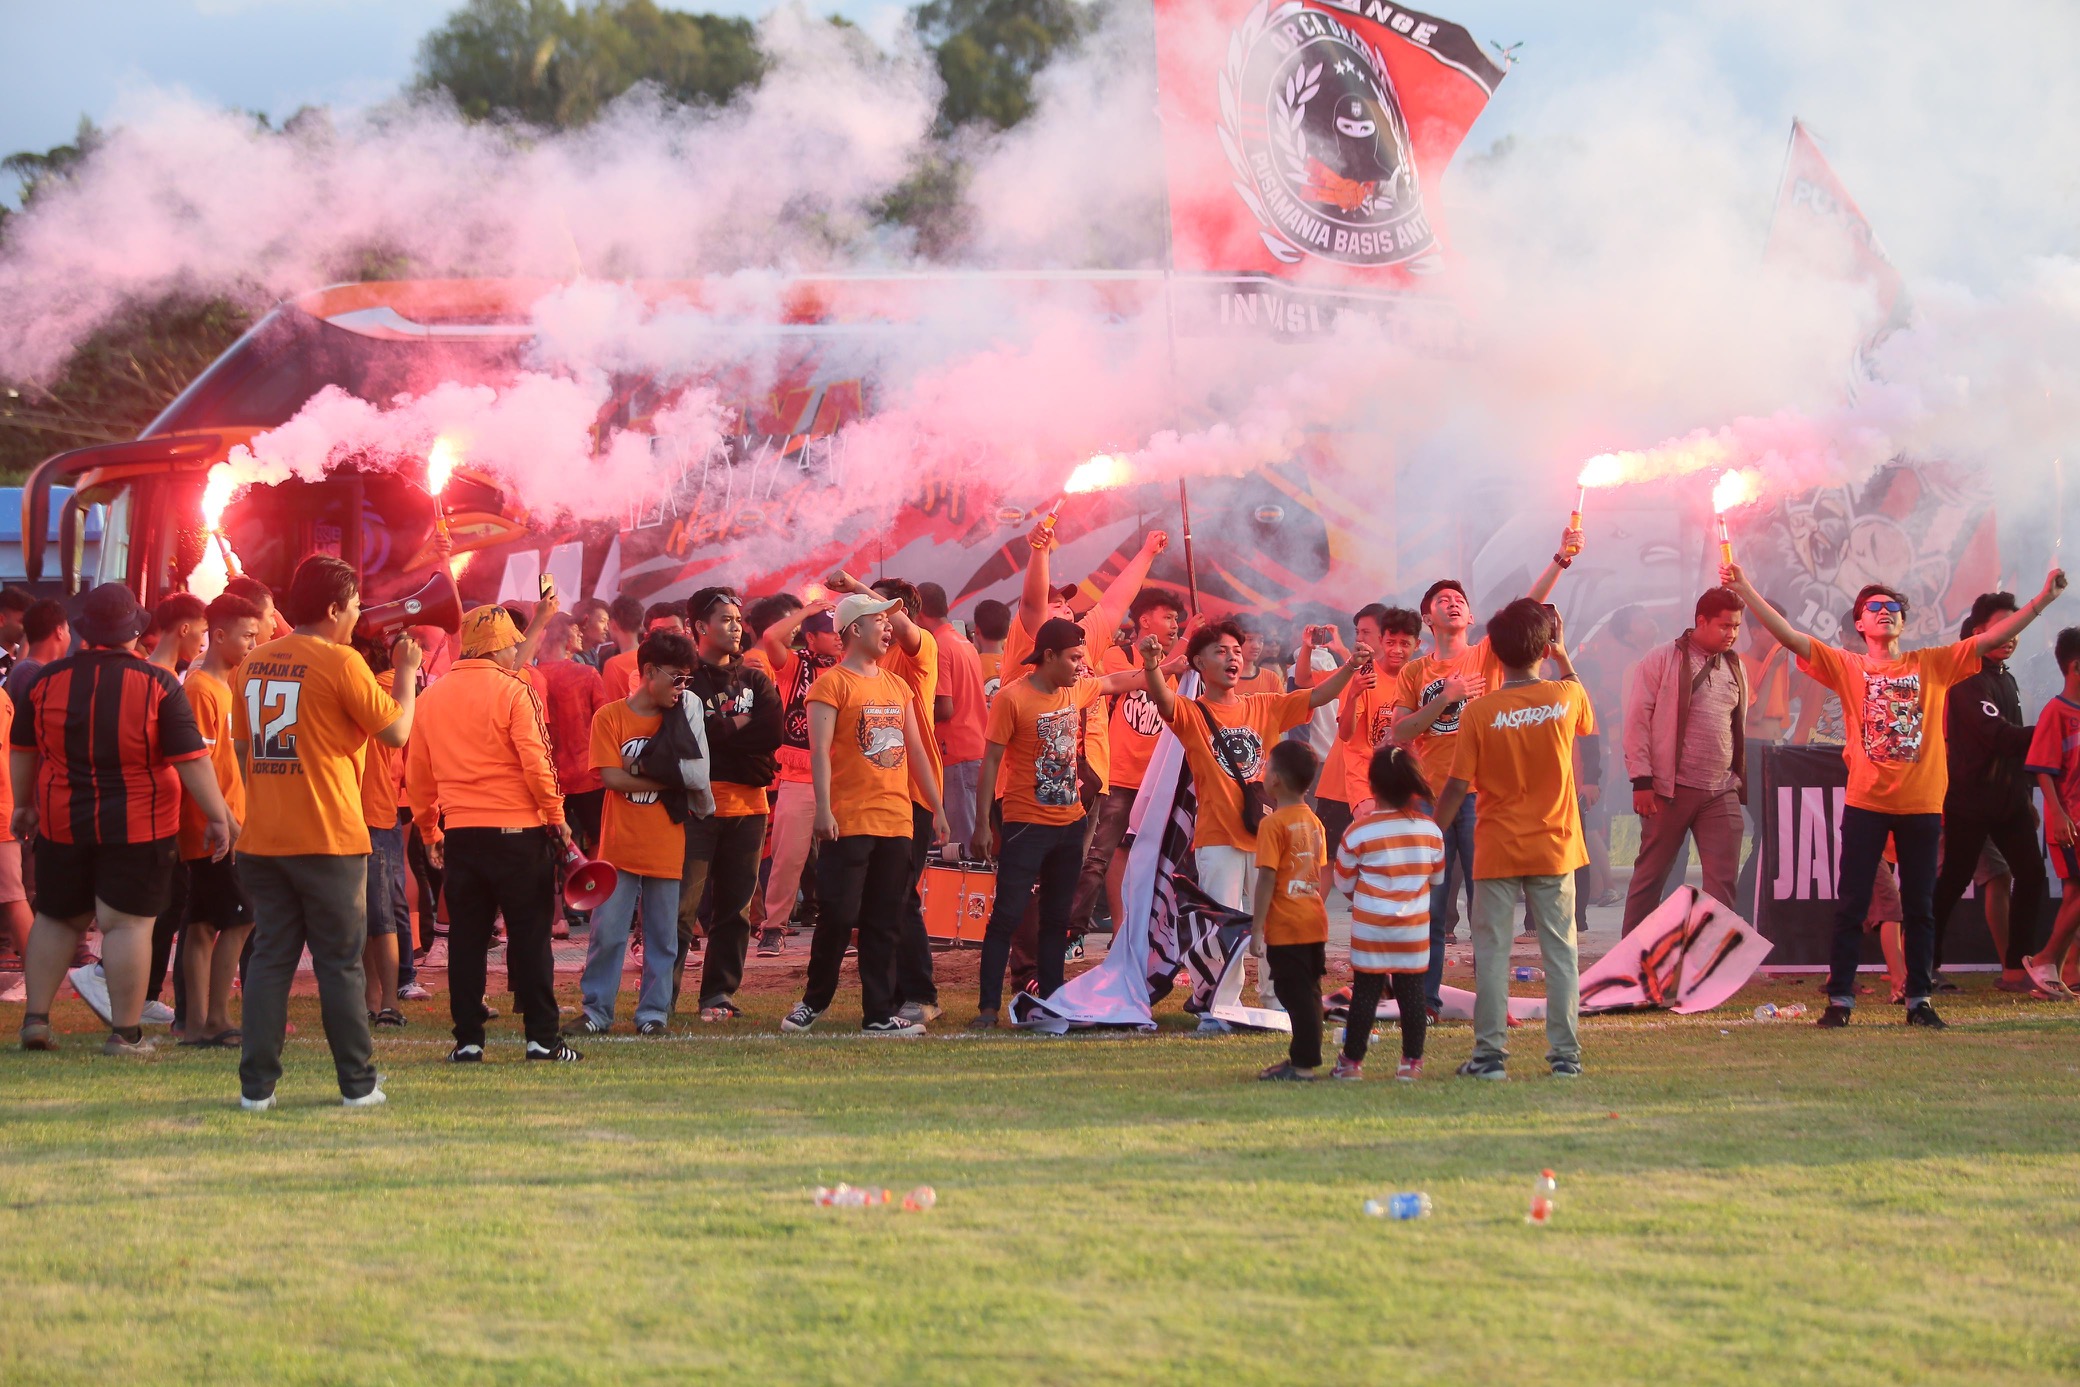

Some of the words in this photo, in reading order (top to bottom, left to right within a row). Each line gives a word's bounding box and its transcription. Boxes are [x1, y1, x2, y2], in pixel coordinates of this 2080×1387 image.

[1271, 13, 1326, 53] ORCA
[1251, 152, 1330, 249] PUSAMANIA
[1333, 229, 1394, 256] BASIS
[246, 662, 289, 677] PEMAIN
[290, 665, 308, 679] KE
[244, 678, 302, 760] 12
